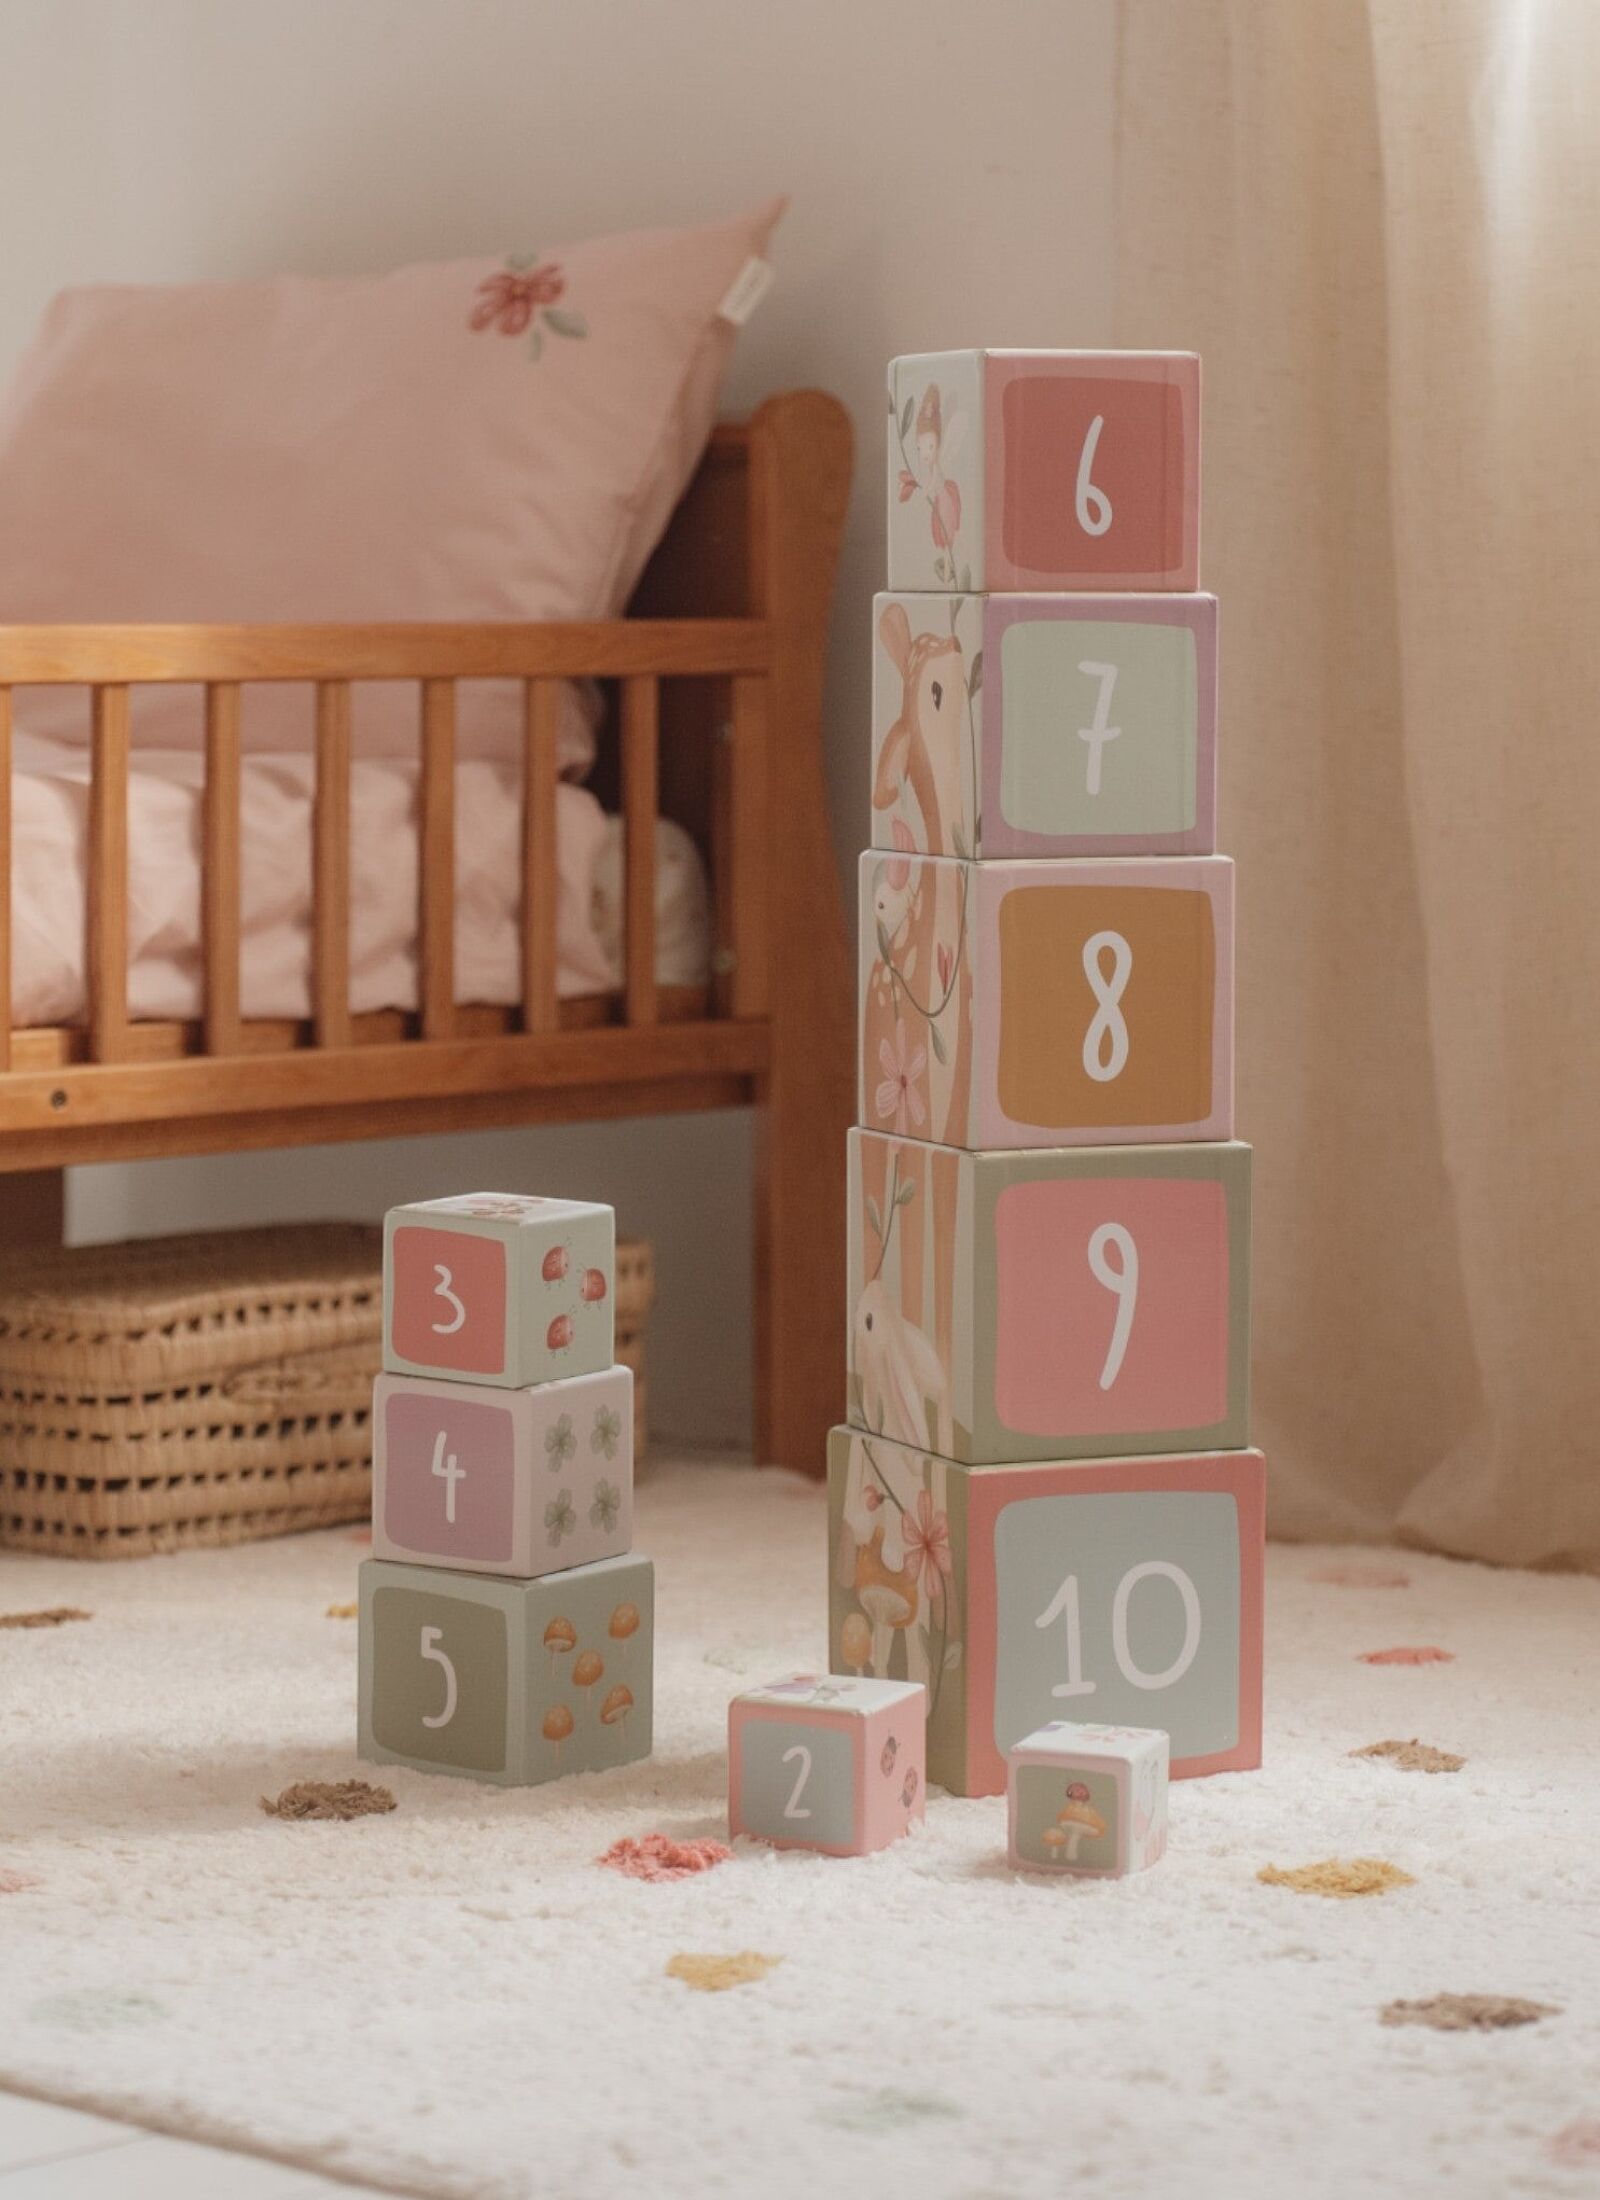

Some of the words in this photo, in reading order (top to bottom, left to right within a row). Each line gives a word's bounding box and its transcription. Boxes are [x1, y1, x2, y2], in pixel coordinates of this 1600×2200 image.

[1075, 415, 1113, 536] 6
[1078, 660, 1122, 795] 7
[1082, 930, 1132, 1082] 8
[431, 1264, 466, 1334] 3
[1087, 1222, 1139, 1391] 9
[431, 1430, 466, 1524] 4
[420, 1625, 458, 1730] 5
[1035, 1561, 1201, 1698] 10
[781, 1745, 813, 1819] 2
